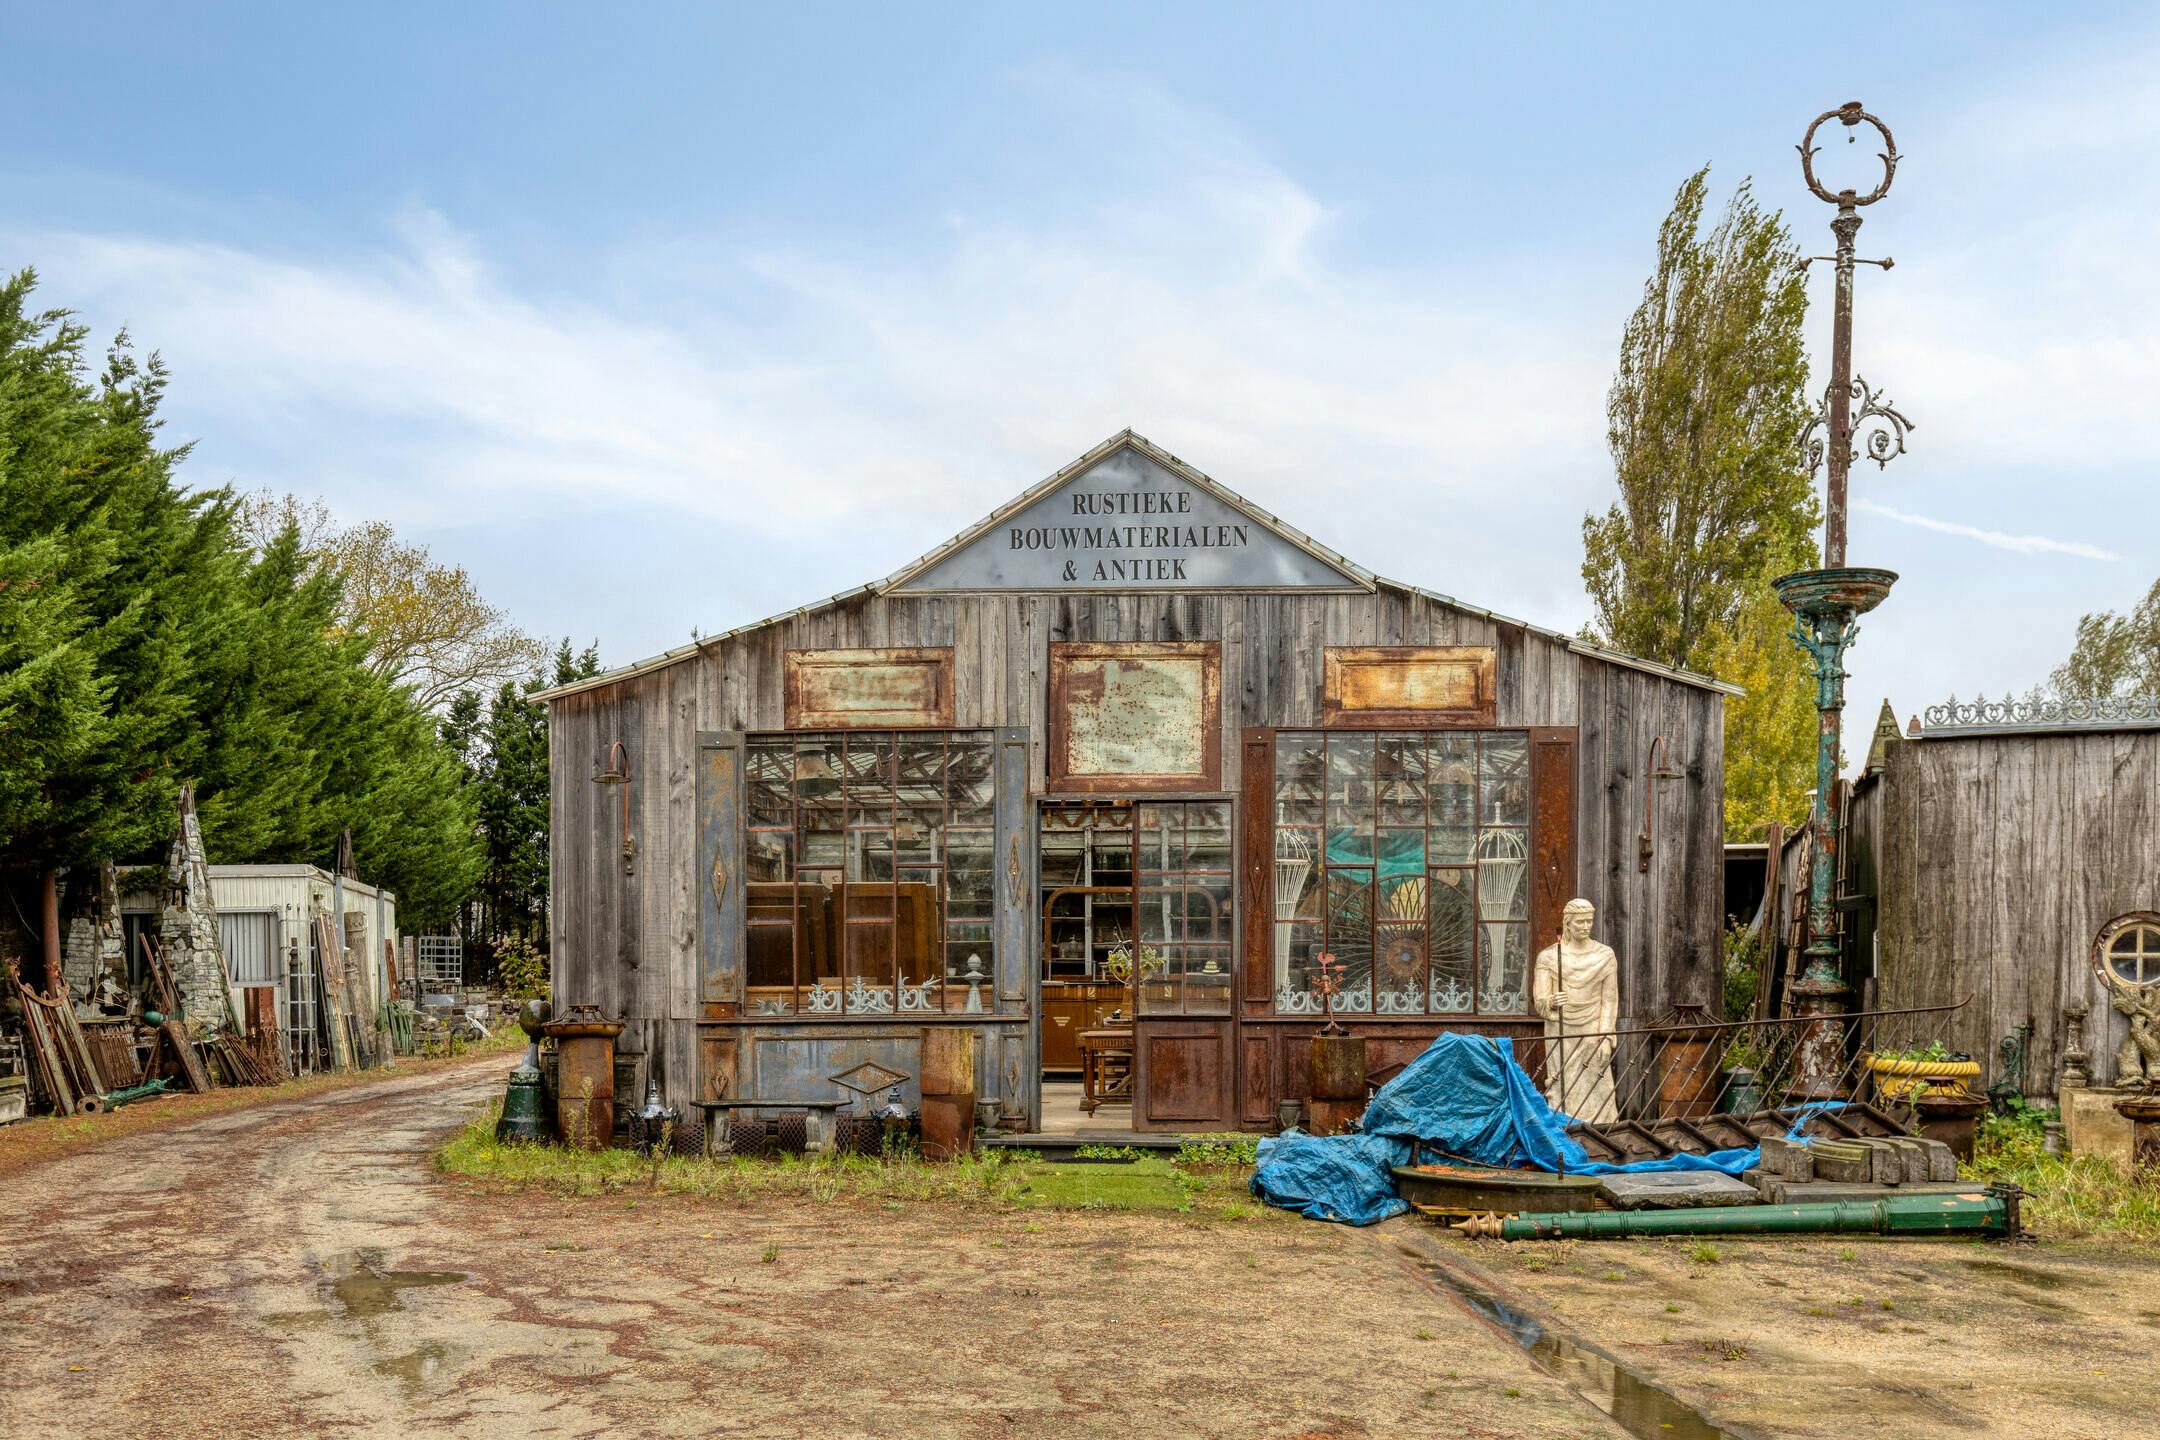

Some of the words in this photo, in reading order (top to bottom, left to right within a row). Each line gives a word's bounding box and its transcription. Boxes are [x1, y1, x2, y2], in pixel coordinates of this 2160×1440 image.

[1072, 492, 1191, 515] RUSTIEKE
[1009, 525, 1249, 550] BOUWMATERIALEN
[1062, 560, 1078, 582] &
[1092, 558, 1187, 581] ANTIEK
